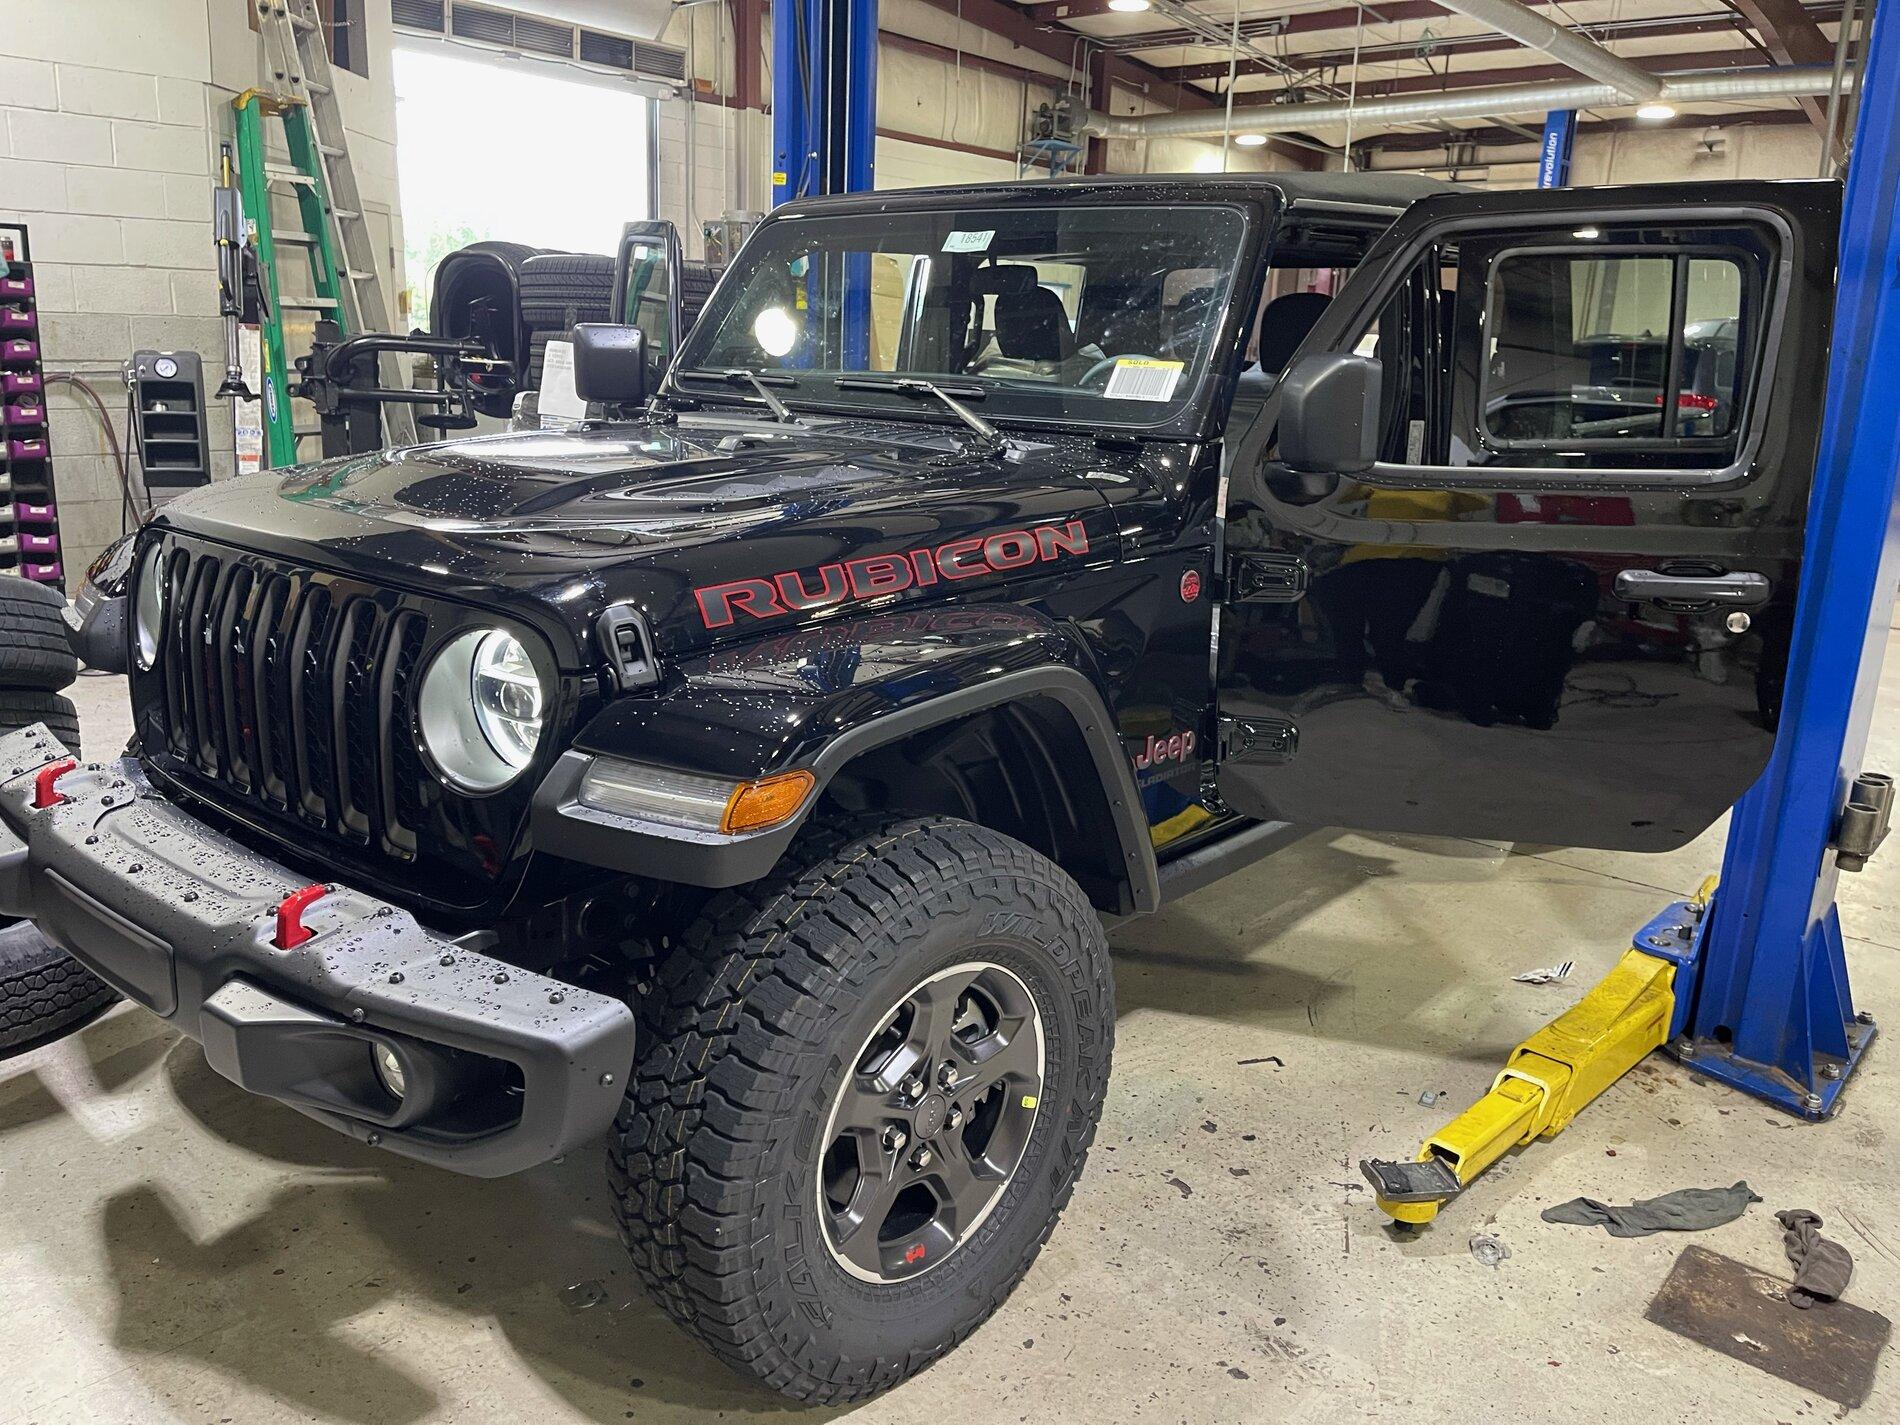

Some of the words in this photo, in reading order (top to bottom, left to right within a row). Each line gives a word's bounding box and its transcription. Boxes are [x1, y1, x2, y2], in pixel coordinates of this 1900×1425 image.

[693, 520, 1090, 629] RUBICON
[1136, 730, 1196, 770] Jeep
[1139, 762, 1196, 788] LADIATOR
[976, 911, 1095, 1090] WILDPEAK
[783, 1053, 843, 1330] FALKEN
